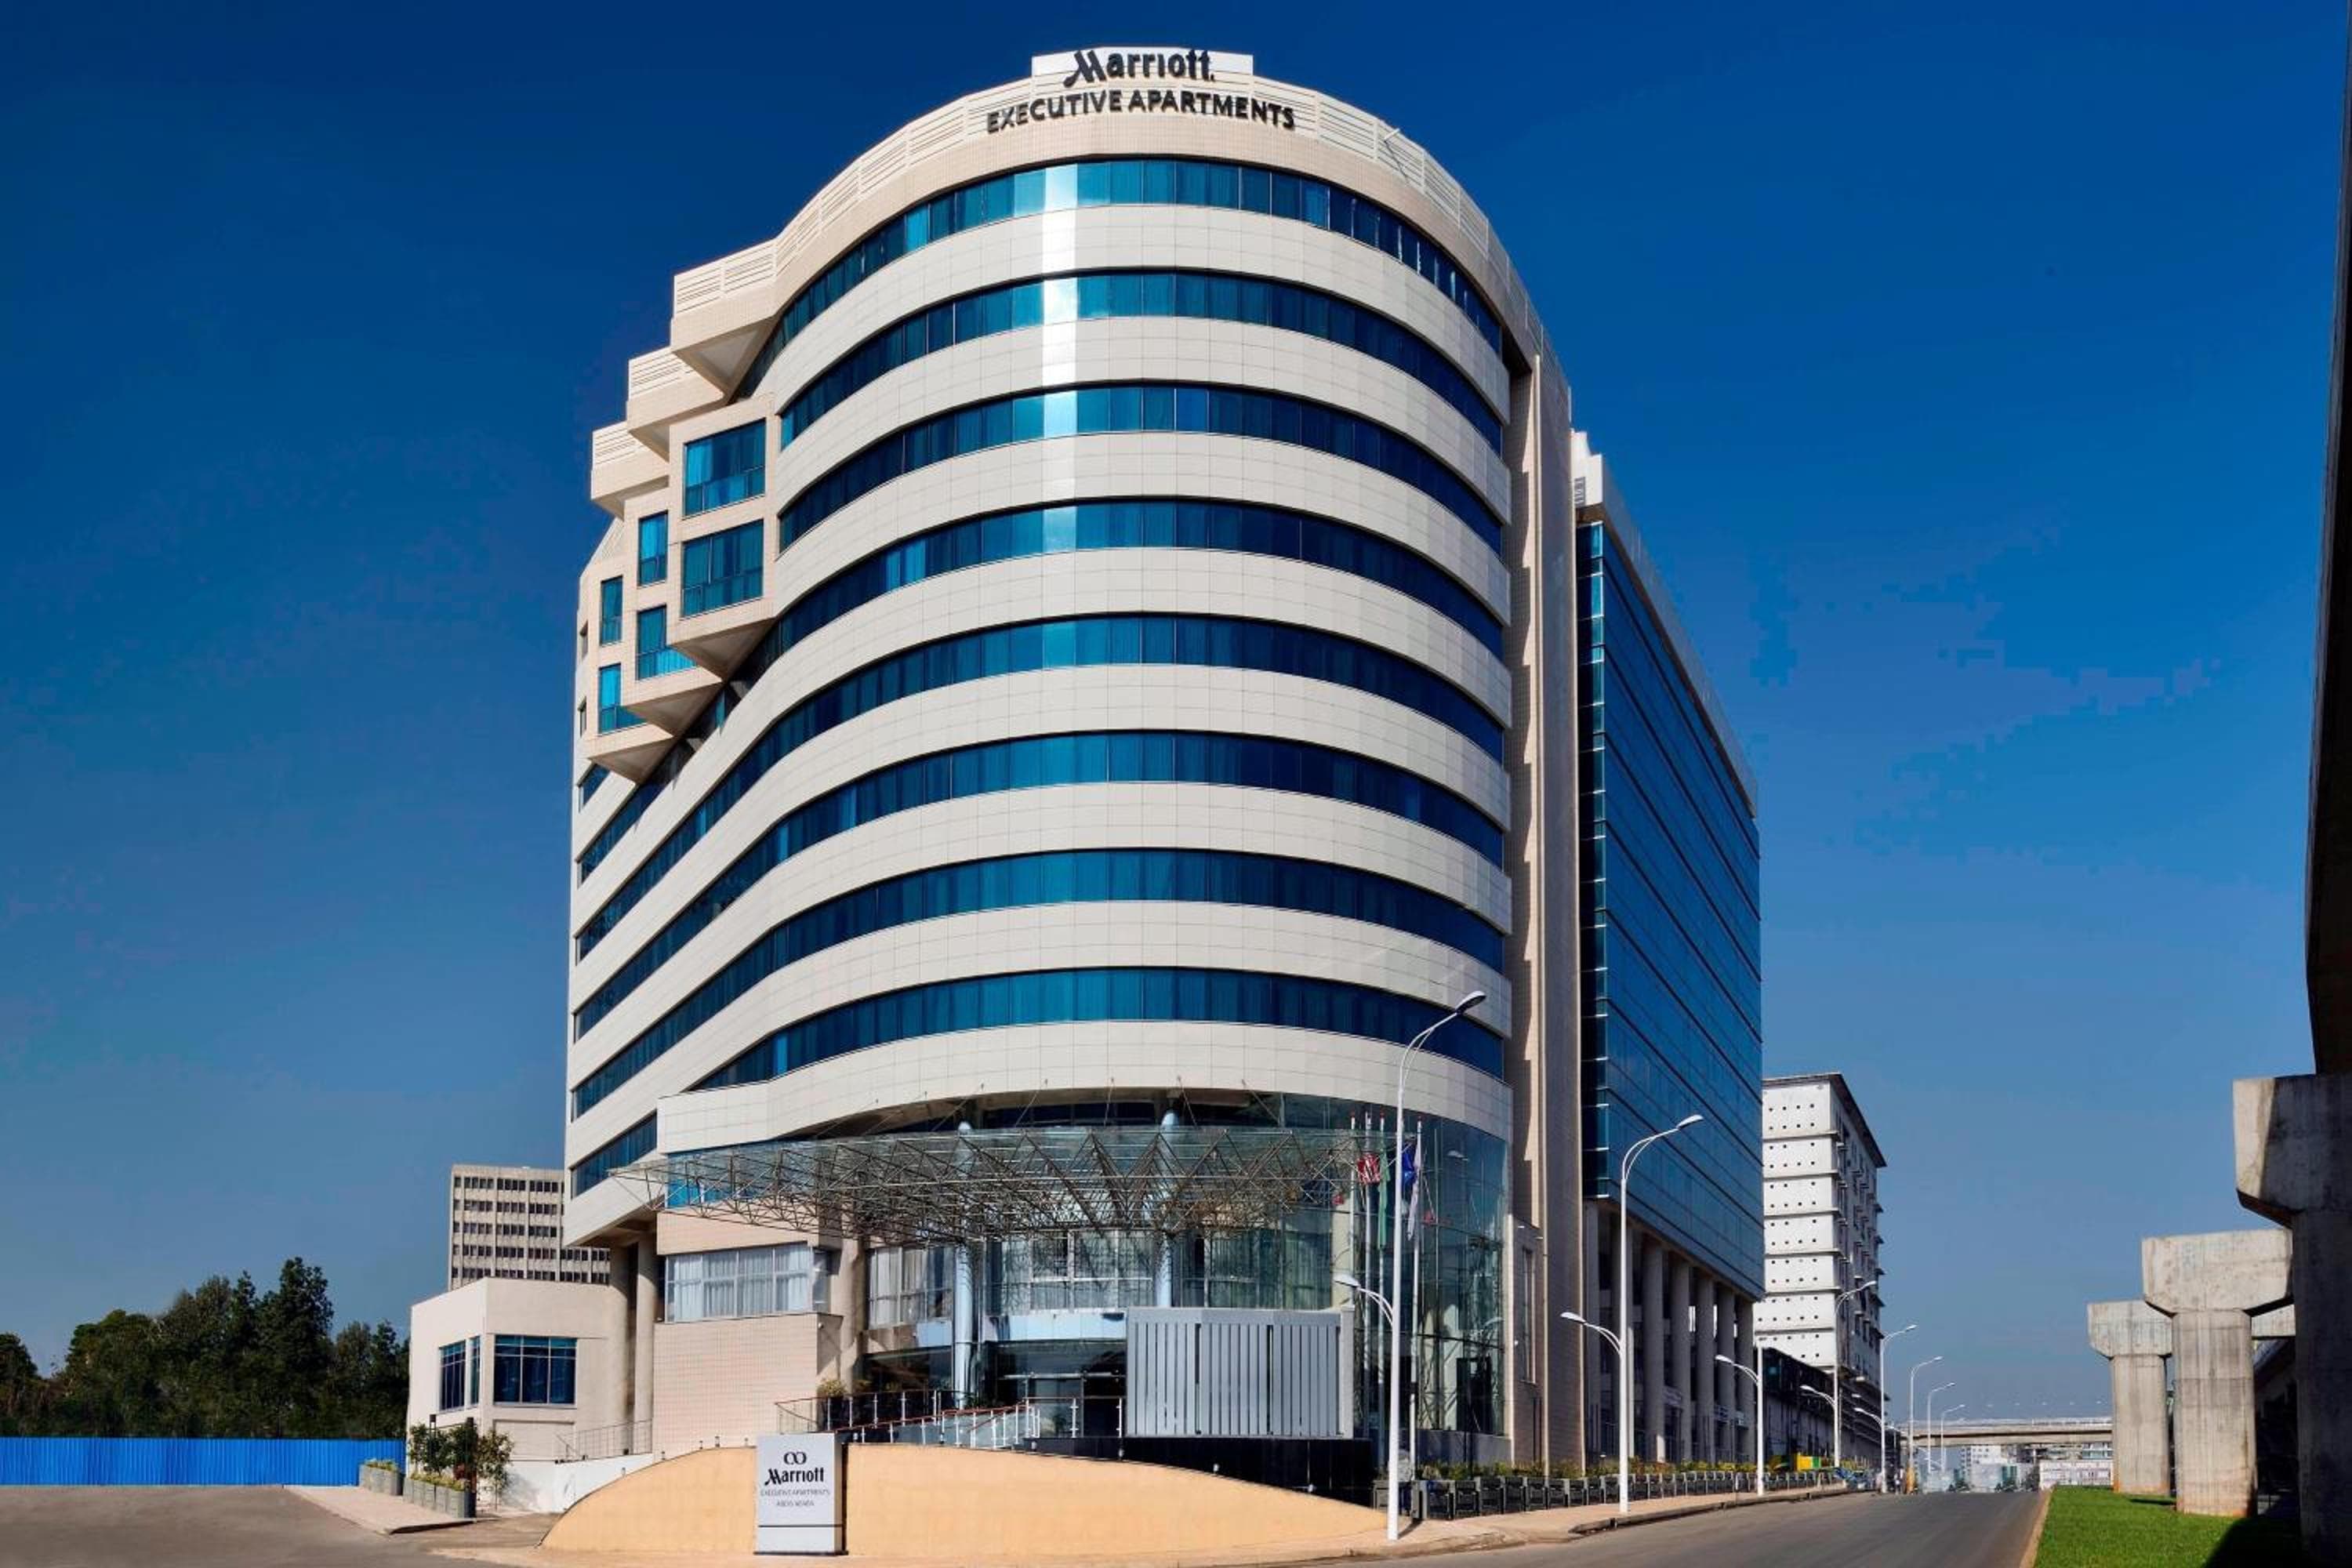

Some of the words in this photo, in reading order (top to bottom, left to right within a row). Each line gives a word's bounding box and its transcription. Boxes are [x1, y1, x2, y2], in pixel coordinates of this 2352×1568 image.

[1063, 49, 1213, 88] Marriott
[987, 89, 1123, 133] EXECUTIVE
[1128, 89, 1295, 131] APARTMENTS
[764, 1467, 824, 1486] Marriott
